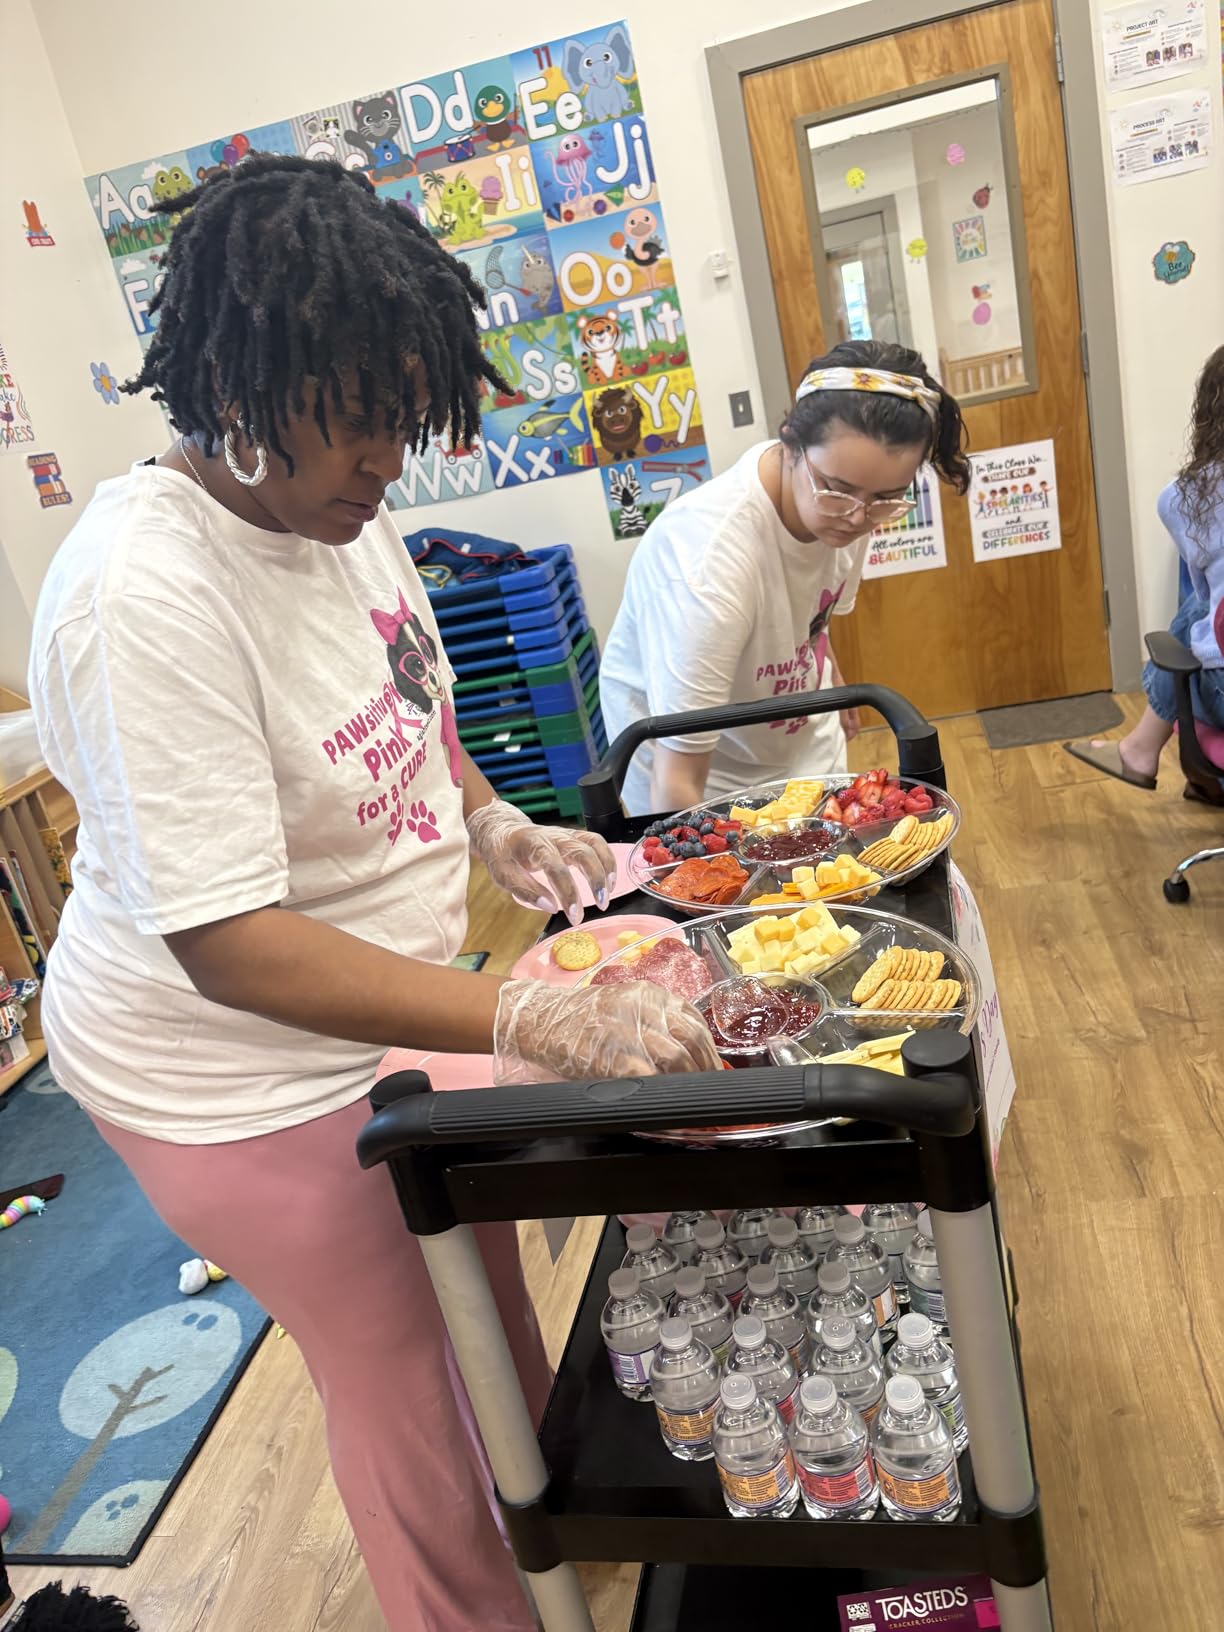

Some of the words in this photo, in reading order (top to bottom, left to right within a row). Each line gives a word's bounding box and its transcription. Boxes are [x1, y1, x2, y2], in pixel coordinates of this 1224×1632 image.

[400, 70, 474, 144] Dd
[519, 76, 583, 141] Ee
[495, 154, 537, 211] Ii
[595, 122, 651, 200] Jj
[98, 173, 157, 230] Aa
[123, 273, 165, 333] F
[559, 251, 633, 306] Oo
[617, 295, 681, 351] Tt
[521, 349, 577, 400] Ss
[633, 376, 697, 443] Yy
[397, 450, 483, 506] Ww
[487, 434, 556, 488] Xx
[871, 539, 888, 552] All
[889, 537, 915, 547] colors
[917, 535, 933, 543] are
[983, 530, 1050, 550] DIFFERENCES
[1005, 515, 1021, 526] and
[868, 544, 938, 566] BEAUTIFUL
[363, 726, 413, 783] Pink
[357, 790, 388, 826] for
[391, 784, 399, 802] a
[400, 740, 428, 790] CURE
[875, 1586, 969, 1621] TOASTEDS
[888, 1619, 921, 1630] CRACKER
